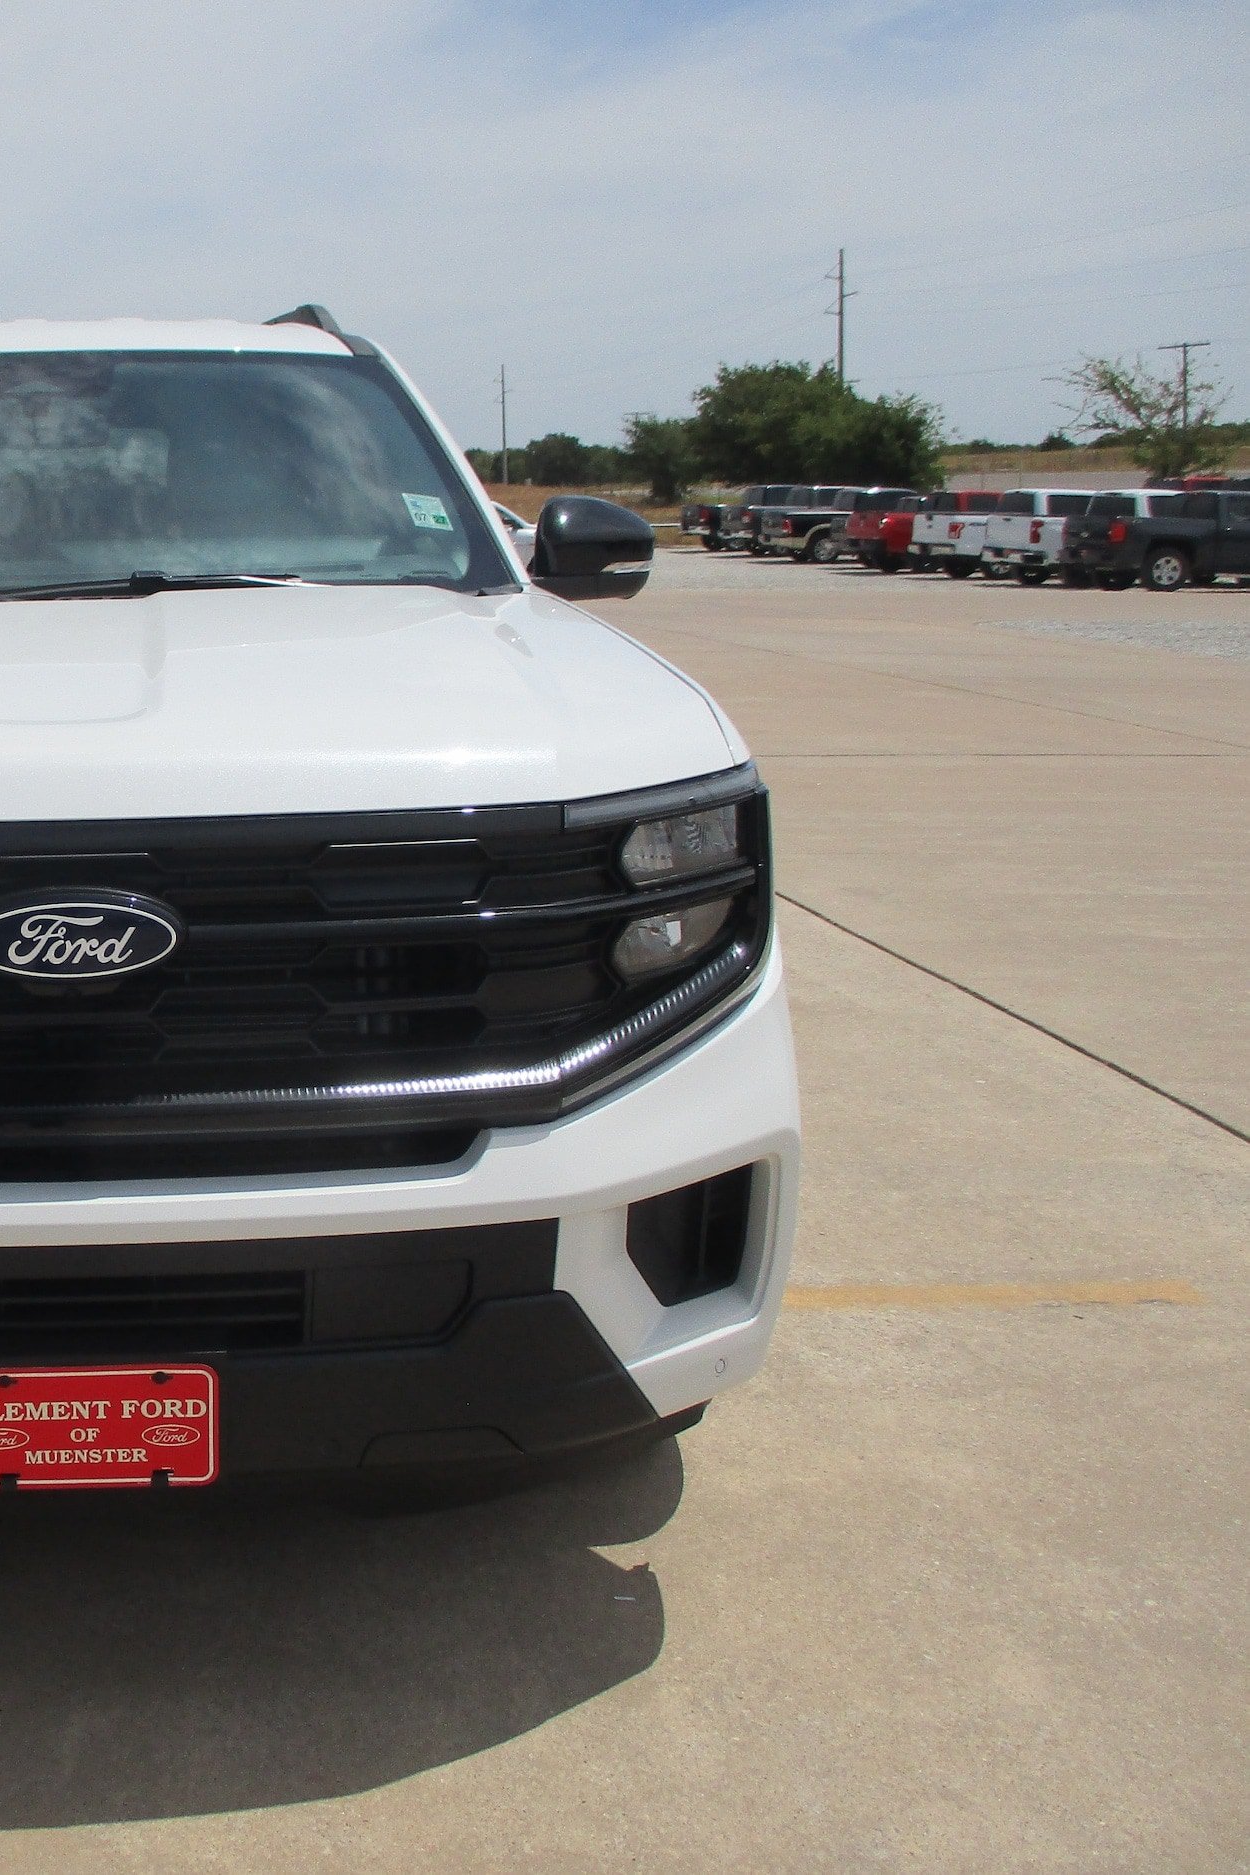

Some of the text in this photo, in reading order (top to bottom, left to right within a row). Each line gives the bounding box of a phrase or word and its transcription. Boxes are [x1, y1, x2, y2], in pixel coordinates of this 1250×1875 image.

[7, 914, 137, 966] Ford
[121, 1399, 208, 1419] FORD
[70, 1428, 101, 1443] OF
[152, 1427, 189, 1443] Ford
[24, 1448, 149, 1465] MUENSTER
